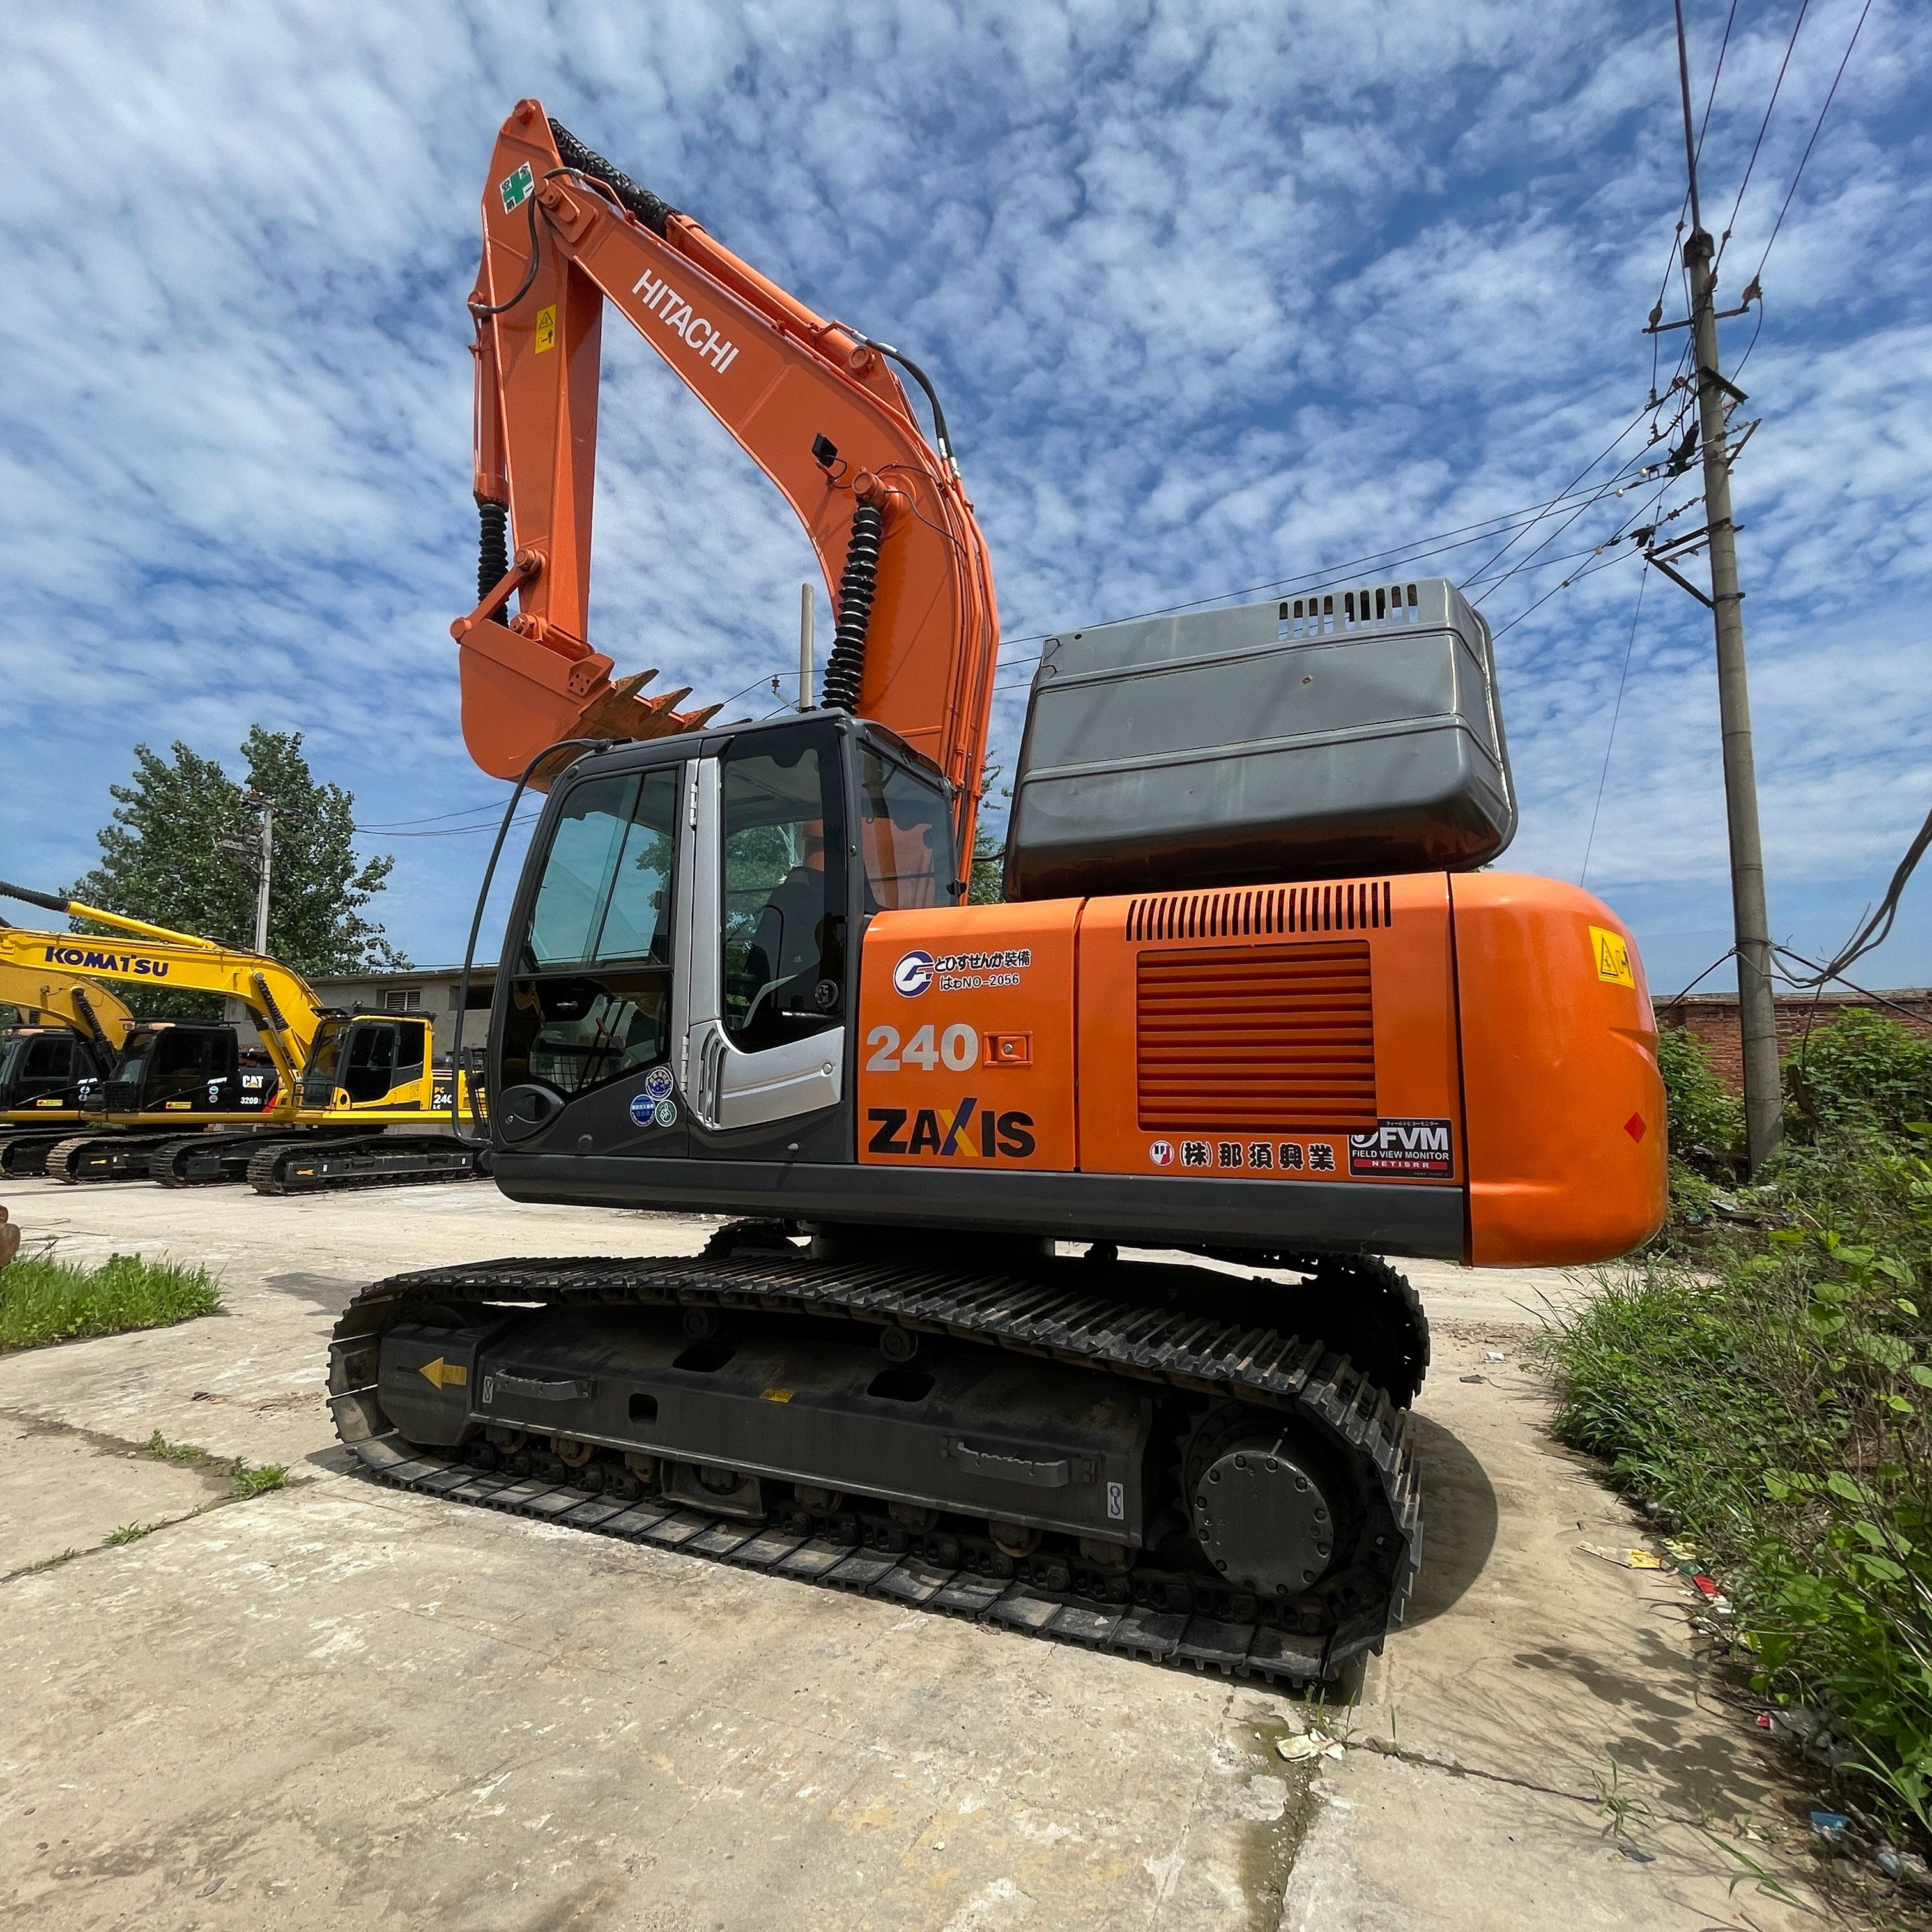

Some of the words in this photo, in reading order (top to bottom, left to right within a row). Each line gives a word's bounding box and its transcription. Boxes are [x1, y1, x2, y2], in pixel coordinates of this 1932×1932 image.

[632, 268, 739, 374] HITACHI
[45, 946, 169, 977] KOMATSU
[866, 1023, 978, 1071] 240
[242, 1075, 264, 1088] CAT
[867, 1098, 1036, 1158] ZAXIS
[1379, 1127, 1449, 1151] FVM
[1352, 1150, 1377, 1158] FIELD
[1379, 1151, 1403, 1159] VIEW
[1405, 1151, 1450, 1160] MONITOR
